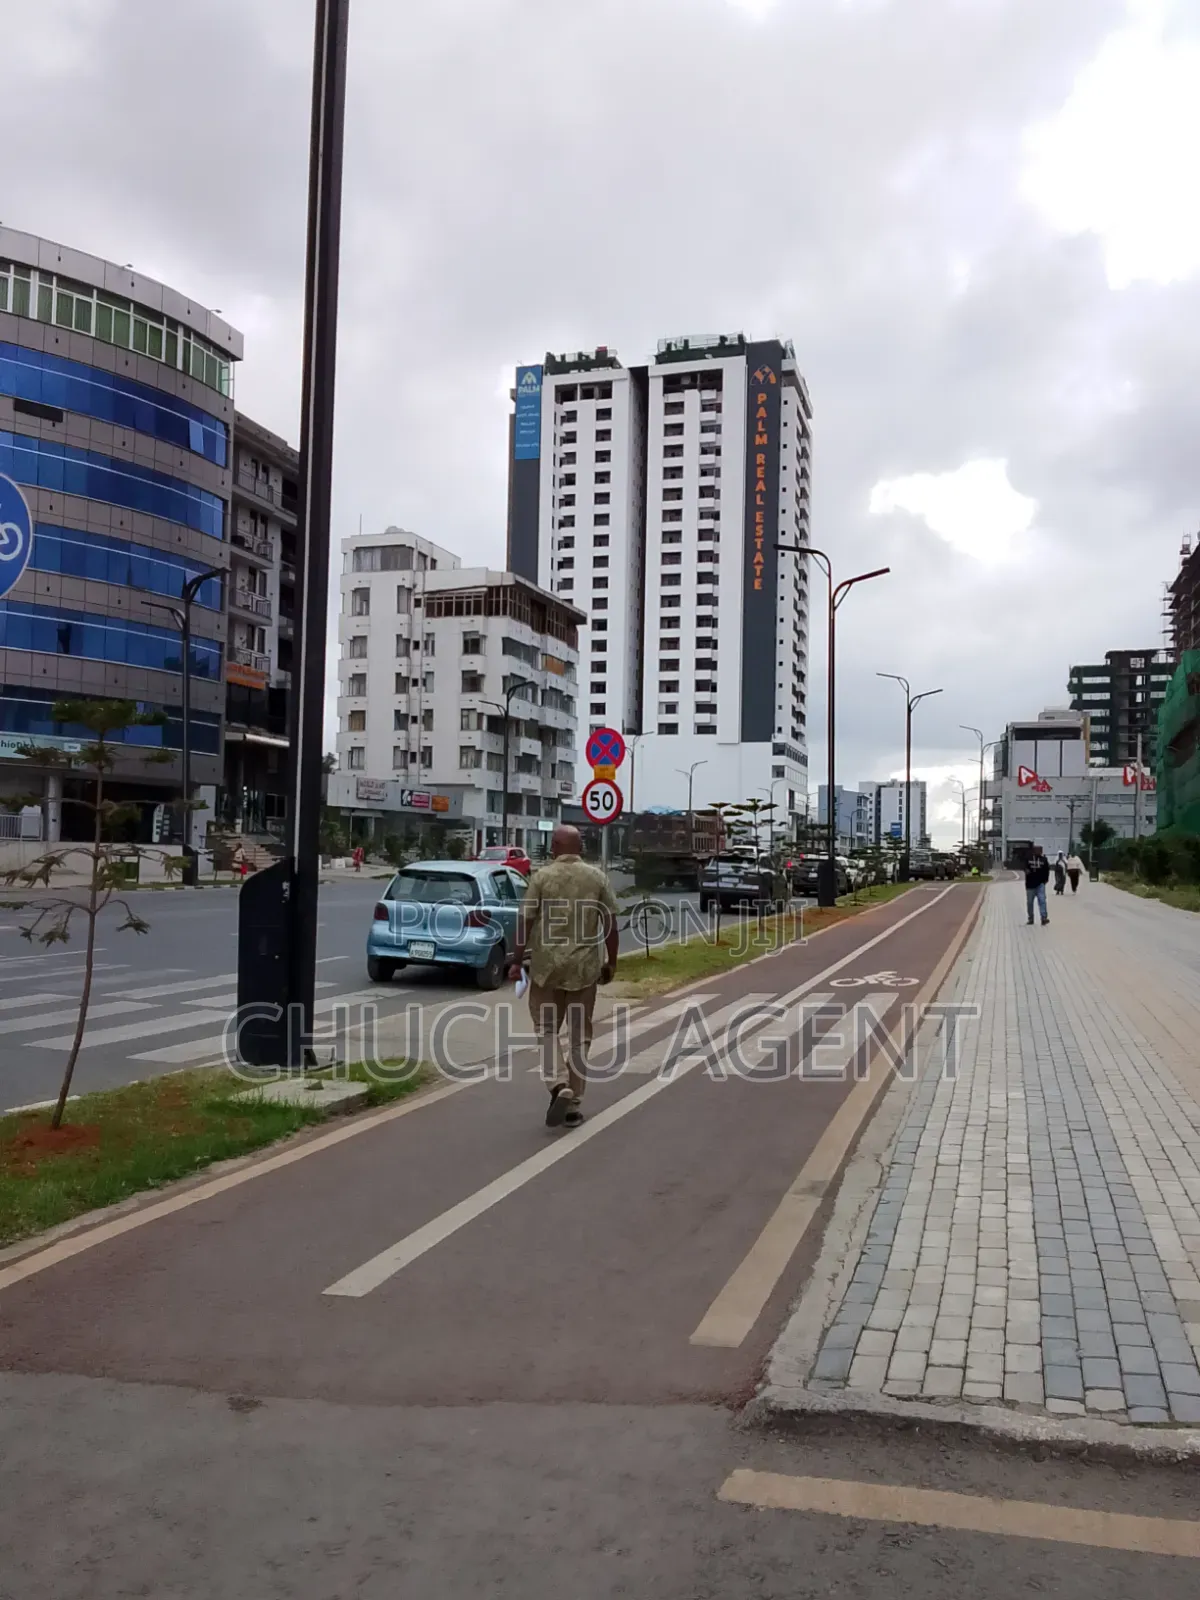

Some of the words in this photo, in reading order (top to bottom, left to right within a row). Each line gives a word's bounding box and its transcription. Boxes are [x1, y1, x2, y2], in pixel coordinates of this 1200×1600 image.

[756, 393, 768, 446] PALM
[755, 453, 766, 505] REAL
[752, 512, 765, 590] ESTATE
[590, 791, 614, 811] 50
